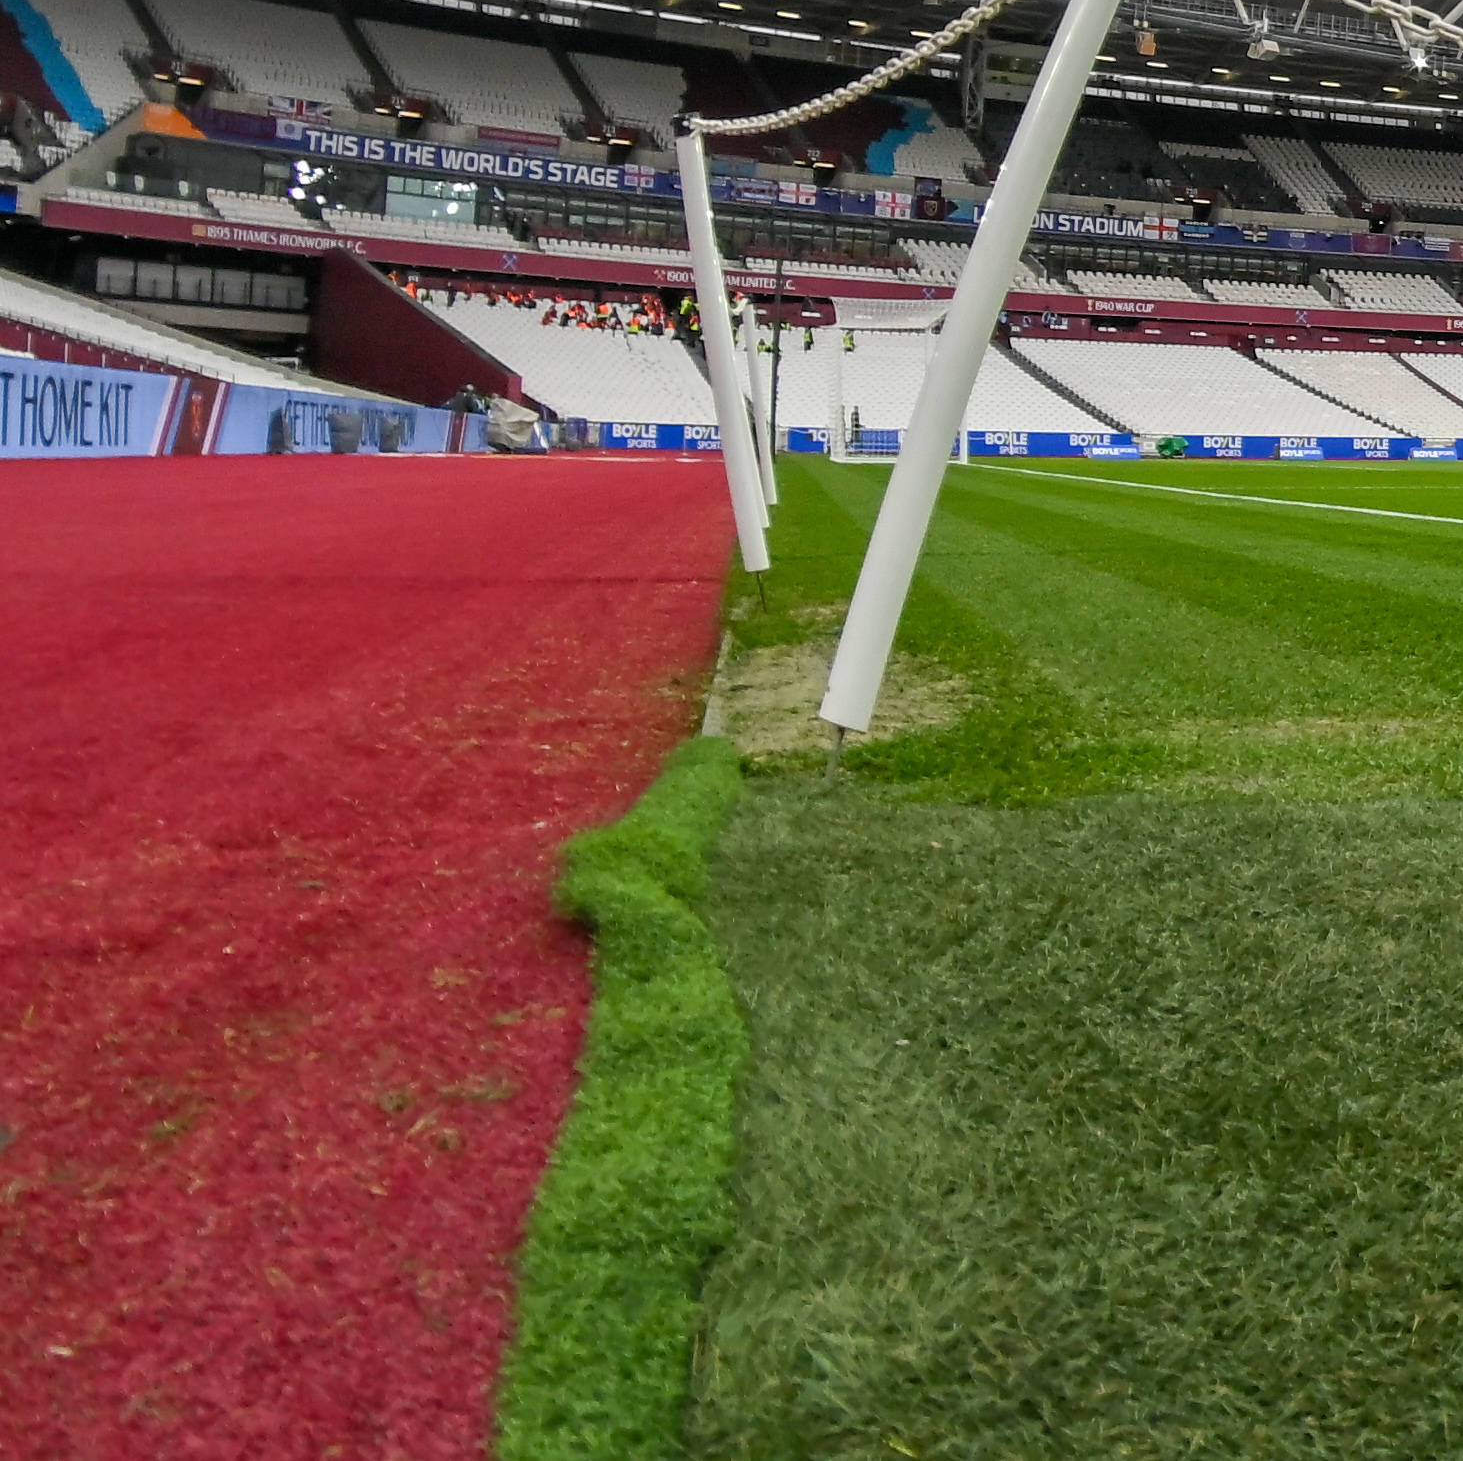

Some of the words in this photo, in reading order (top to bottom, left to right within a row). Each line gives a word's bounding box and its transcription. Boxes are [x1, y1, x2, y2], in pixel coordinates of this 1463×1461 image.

[306, 130, 358, 157] THIS
[363, 138, 385, 160] IS
[390, 141, 435, 166] THE
[440, 147, 543, 180] WORLD'S
[548, 162, 620, 188] STAGE
[1057, 216, 1144, 238] STADIUM
[233, 228, 278, 245] THAMES
[741, 277, 777, 288] UNITED
[1115, 302, 1135, 313] WAR
[1135, 303, 1155, 314] CUP
[20, 374, 93, 447] HOME
[99, 382, 133, 446] KIT
[612, 424, 657, 438] BOYLE
[683, 426, 720, 440] BOYL
[626, 439, 657, 449] SPORTS
[984, 433, 1028, 446] BOYLE
[1069, 434, 1111, 446] BOYLE
[1203, 437, 1242, 449] BOYLE
[1280, 437, 1318, 448] BOYLE
[1353, 438, 1389, 450] BOYLE
